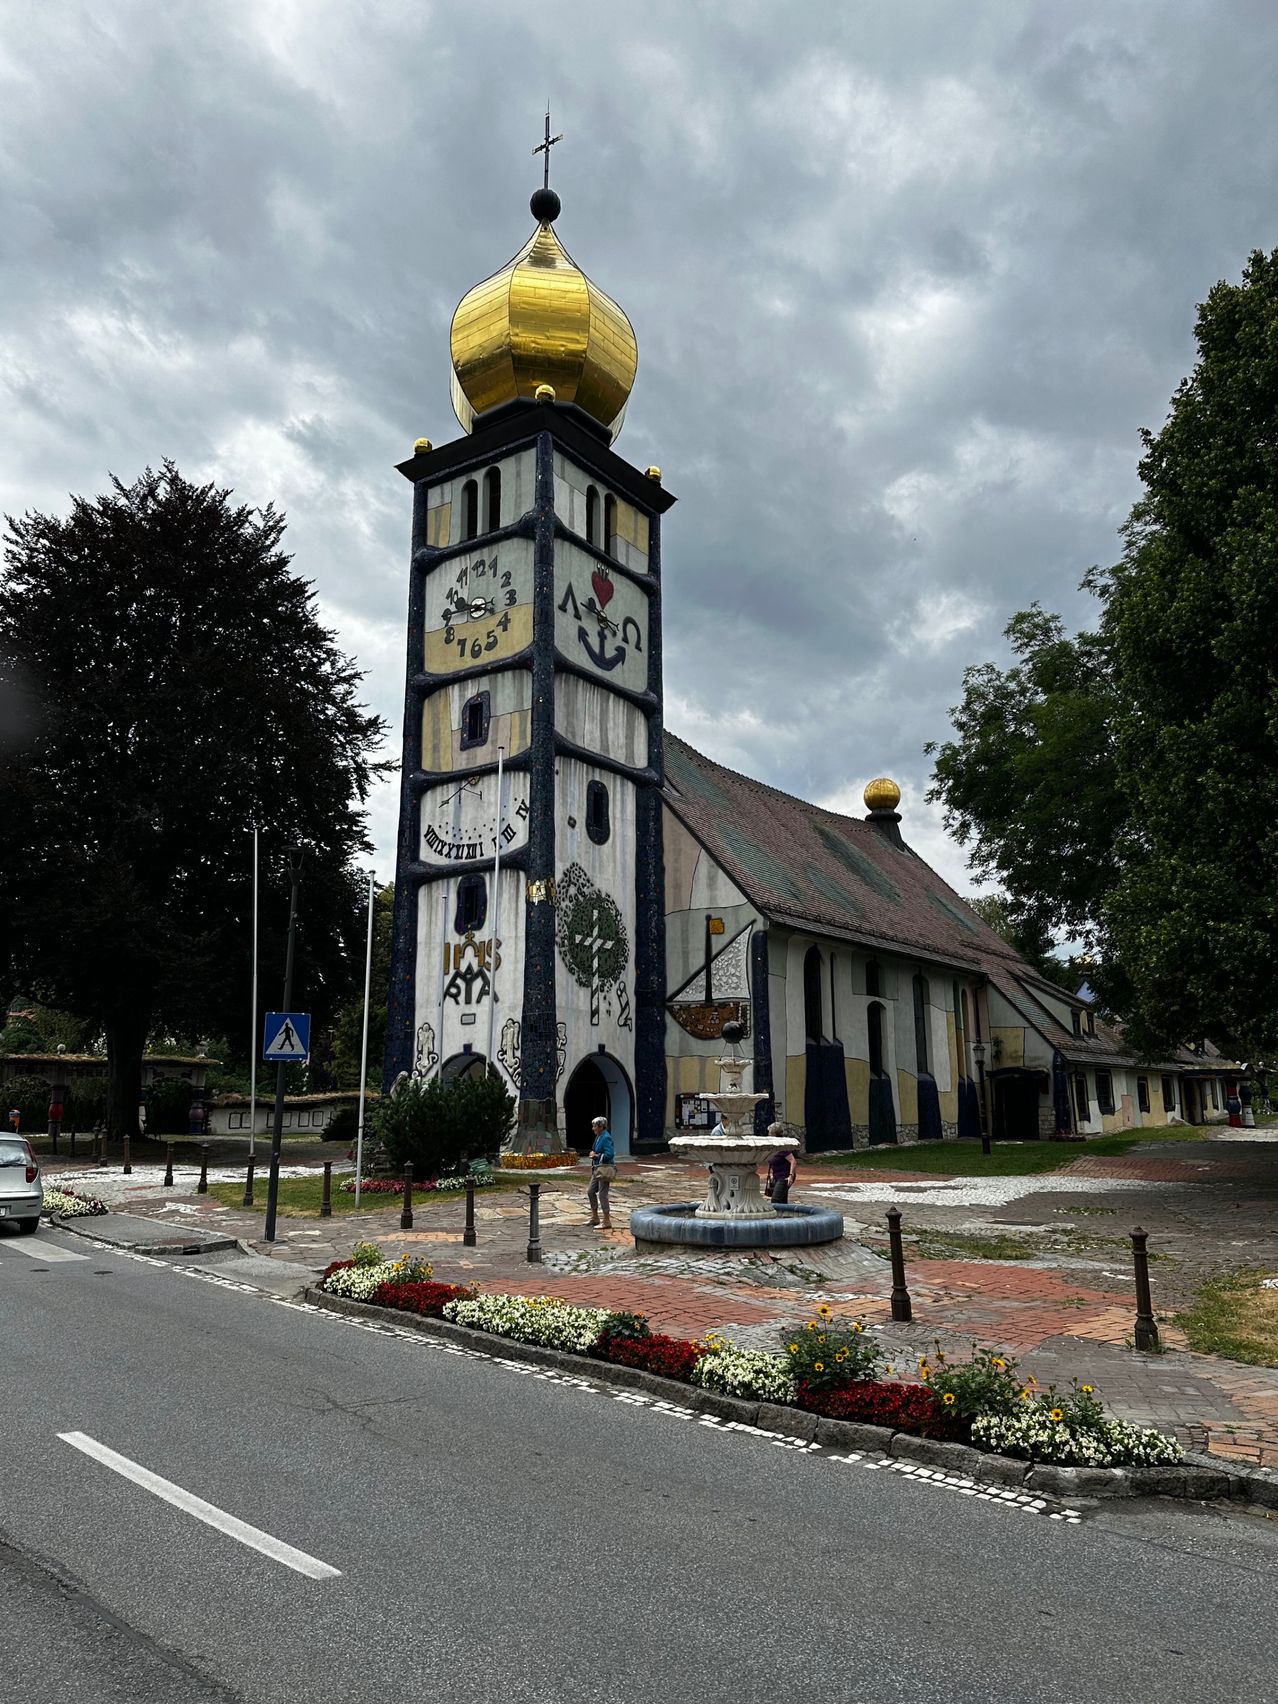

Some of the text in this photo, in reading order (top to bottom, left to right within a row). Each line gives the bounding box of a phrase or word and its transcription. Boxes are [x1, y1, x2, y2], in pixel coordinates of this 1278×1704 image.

[472, 559, 486, 578] 12
[488, 555, 498, 578] 1
[456, 567, 468, 589] 11
[501, 571, 512, 588] 2
[446, 587, 460, 606] 10
[504, 589, 518, 606] 3
[496, 611, 511, 632] 4
[444, 627, 455, 644] 8
[484, 630, 498, 651] 5
[457, 638, 467, 657] 7
[470, 638, 482, 659] 6
[501, 823, 517, 844] III
[465, 843, 478, 860] XII
